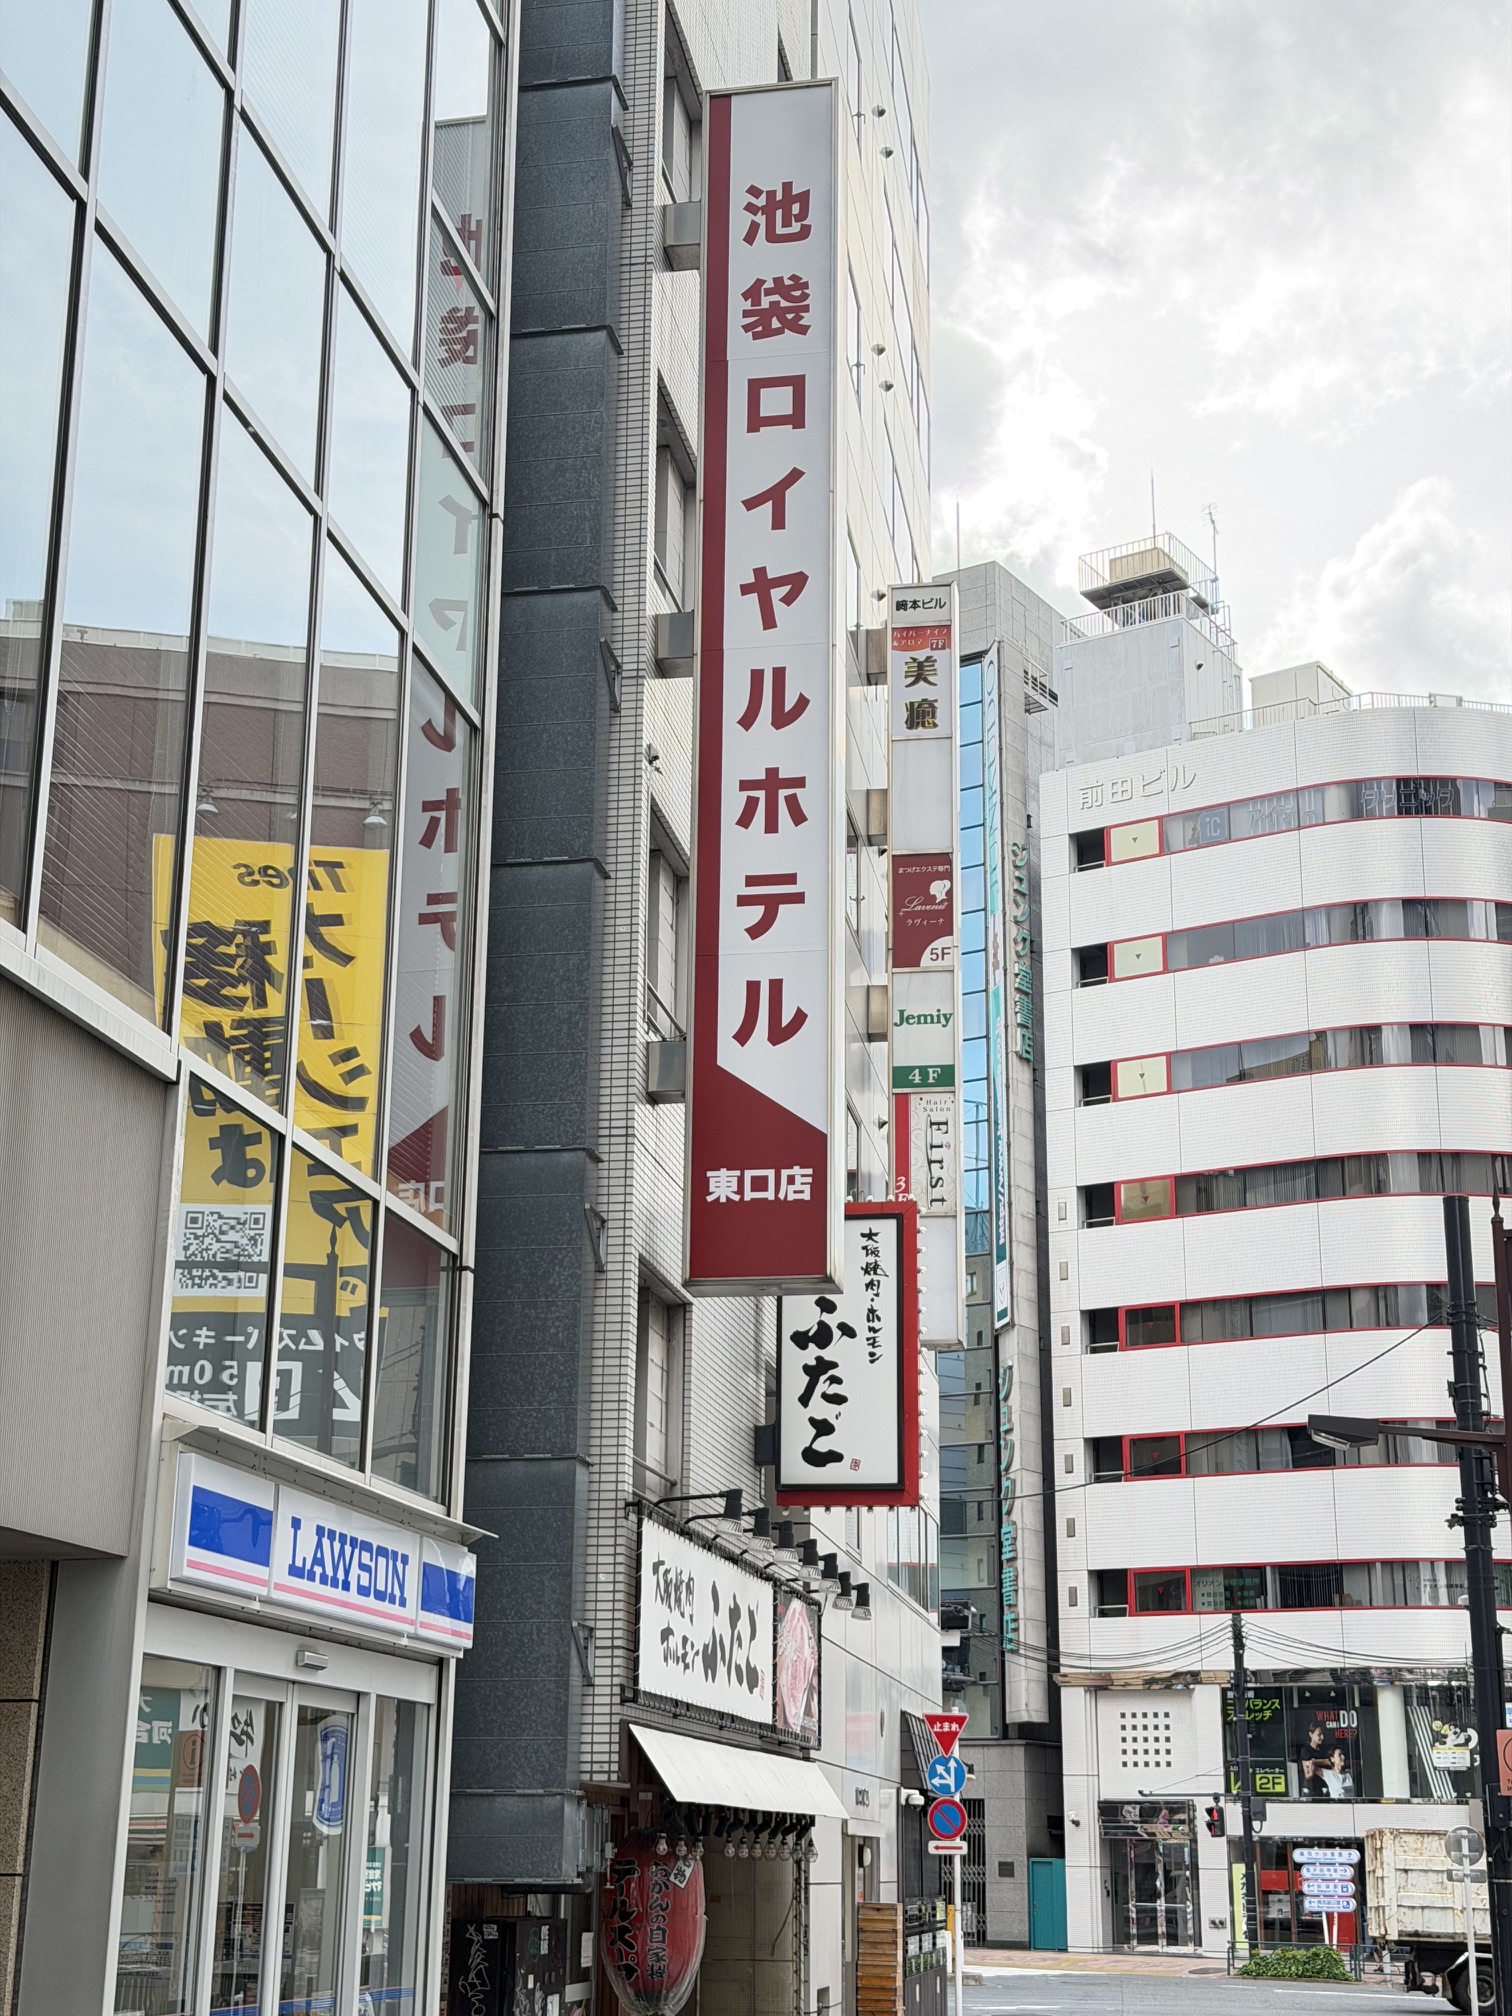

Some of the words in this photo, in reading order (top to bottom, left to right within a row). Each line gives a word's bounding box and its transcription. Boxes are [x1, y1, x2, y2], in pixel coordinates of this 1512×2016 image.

[732, 180, 813, 1047] 池袋ロイヤルホテル
[931, 639, 945, 649] 7F
[986, 660, 999, 894] JUNKUDO
[1078, 764, 1197, 811] 前田ビル
[906, 918, 944, 926] ラヴィーナ
[930, 947, 951, 962] 5F
[1011, 841, 1034, 1062] ジュンク堂書店
[893, 1009, 953, 1028] Jemiy
[706, 1165, 813, 1203] 東口店
[929, 1118, 949, 1207] First
[860, 1227, 889, 1364] 大阪焼肉・ホルモン
[789, 1296, 857, 1467] ふたご
[288, 1515, 409, 1608] LAWSON
[652, 1552, 695, 1627] 大阪焼肉
[660, 1620, 700, 1676] ホルモン
[702, 1580, 759, 1695] ふたご
[933, 1721, 960, 1733] 止まれ
[1227, 1710, 1272, 1720] スレッチ
[1316, 1711, 1338, 1721] WHAT
[1335, 1728, 1357, 1738] HERE?
[1340, 1710, 1357, 1728] DO
[1258, 1776, 1282, 1791] 2F
[608, 1858, 640, 1982] テールスープ
